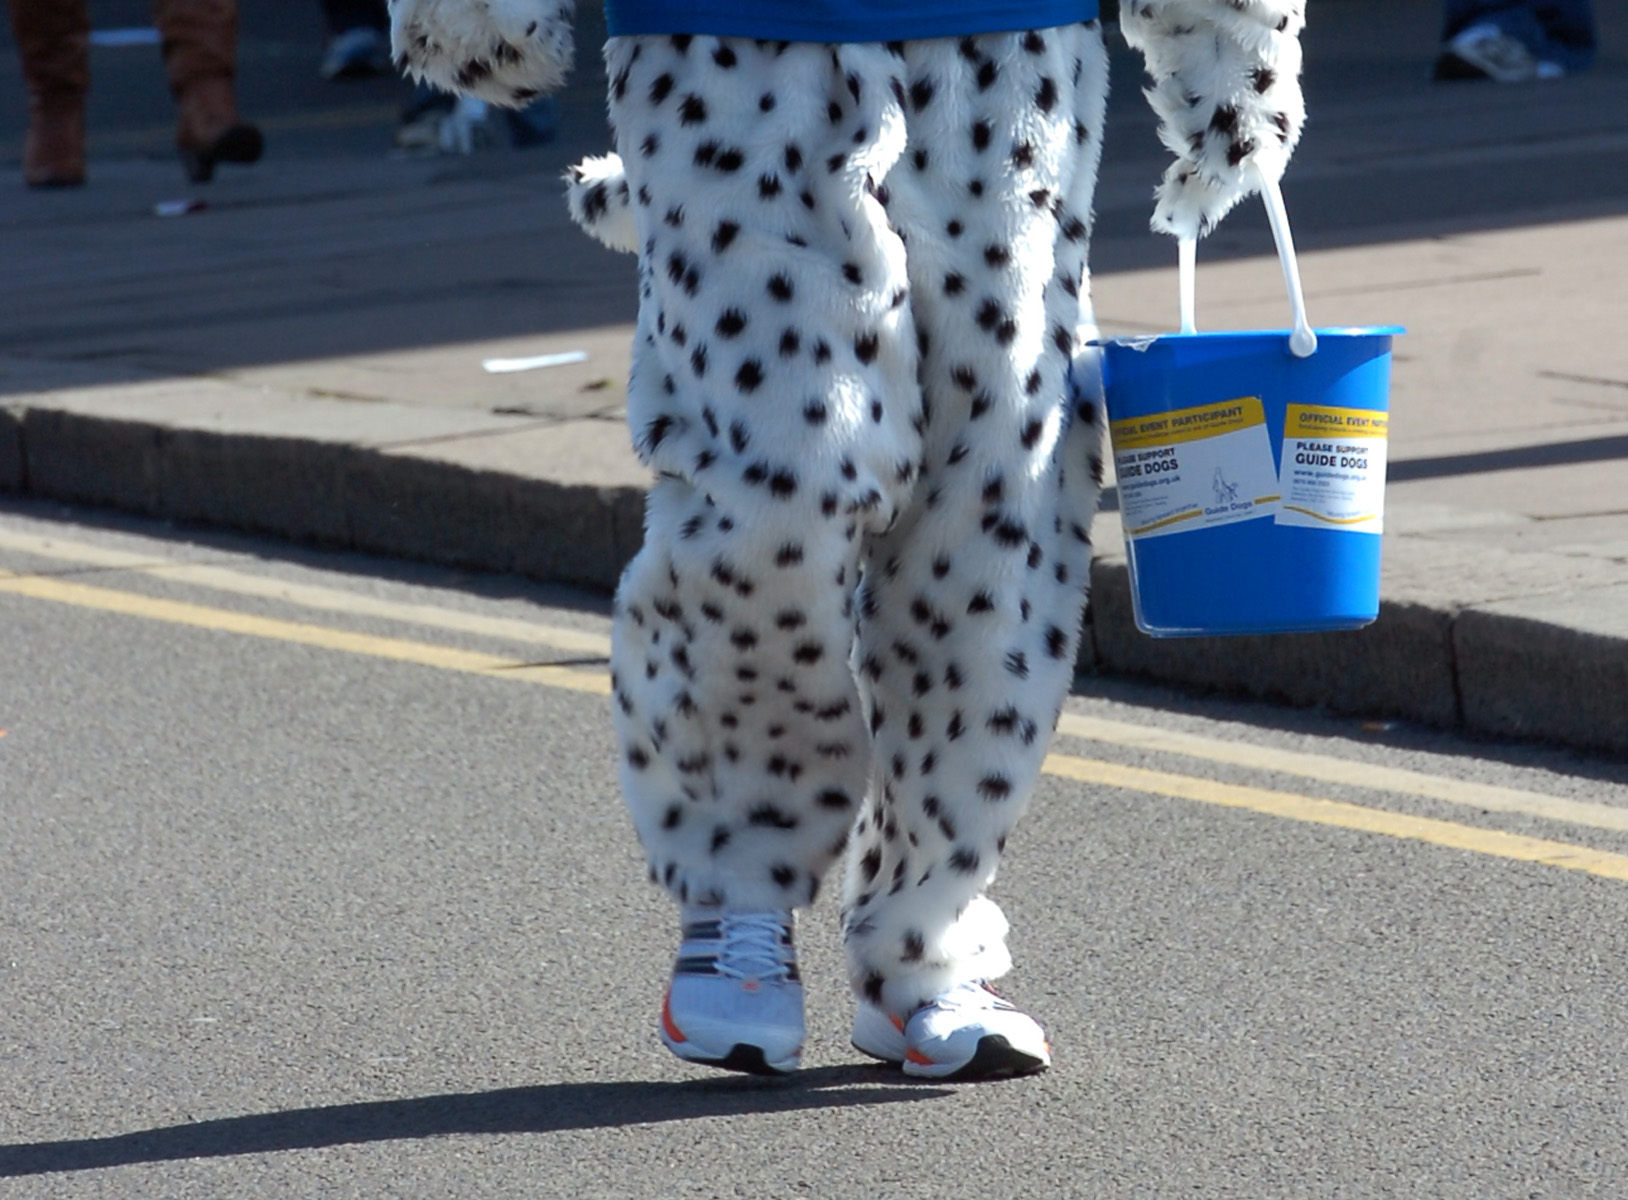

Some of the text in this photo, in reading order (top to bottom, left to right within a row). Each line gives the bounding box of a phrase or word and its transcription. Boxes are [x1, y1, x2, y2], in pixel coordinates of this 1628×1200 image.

[1172, 406, 1244, 427] PARTICIPANT
[1299, 412, 1344, 426] OFFICIAL
[1138, 448, 1175, 462] SUPPORT
[1296, 441, 1369, 455] PLEASE SUPPORT
[1145, 459, 1178, 475] DOGS
[1295, 453, 1368, 469] GUIDE DOGS
[1230, 501, 1253, 513] Dogs
